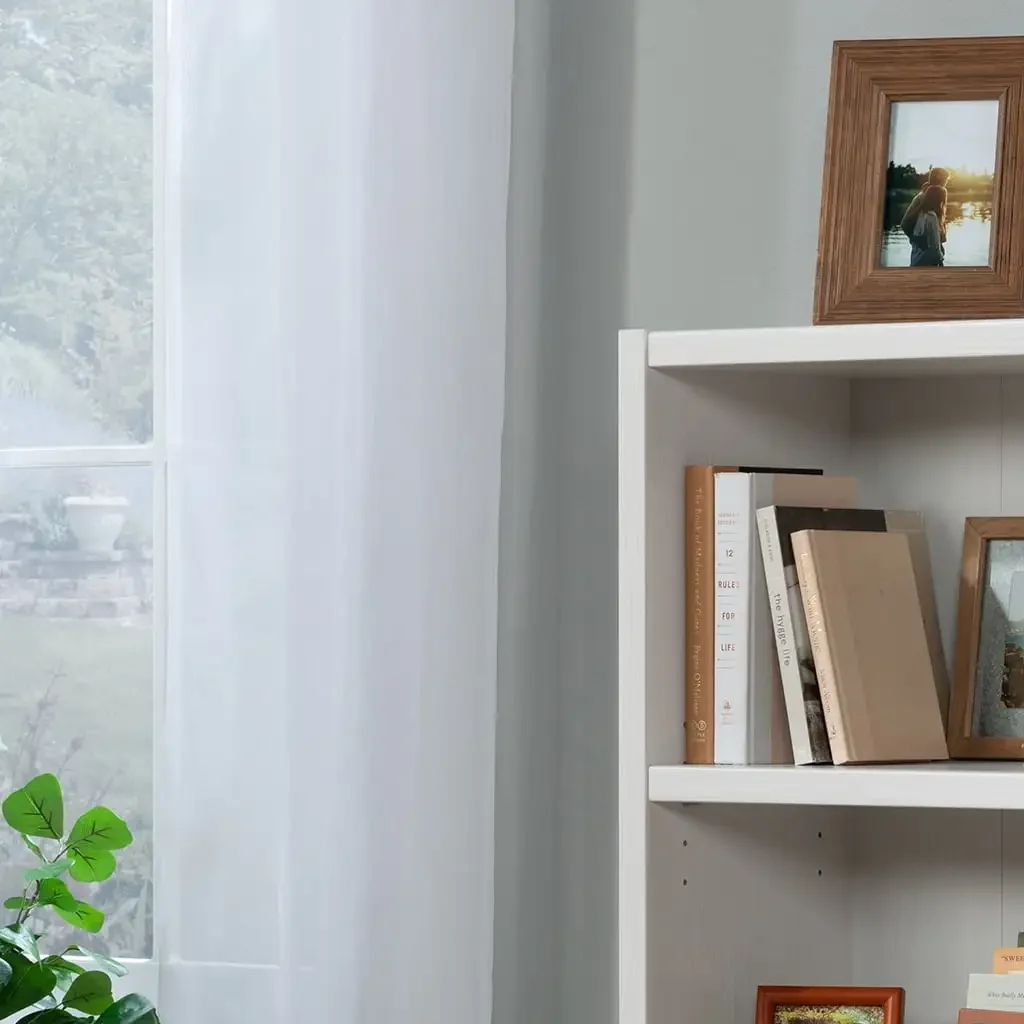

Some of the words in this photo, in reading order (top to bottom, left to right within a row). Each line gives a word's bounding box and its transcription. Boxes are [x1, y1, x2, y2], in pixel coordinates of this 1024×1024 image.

[725, 549, 734, 558] 12
[718, 580, 740, 589] RULES
[774, 593, 782, 612] the
[722, 611, 736, 621] FOR
[775, 615, 787, 645] hygge
[720, 643, 736, 652] LIFE
[782, 648, 791, 667] life
